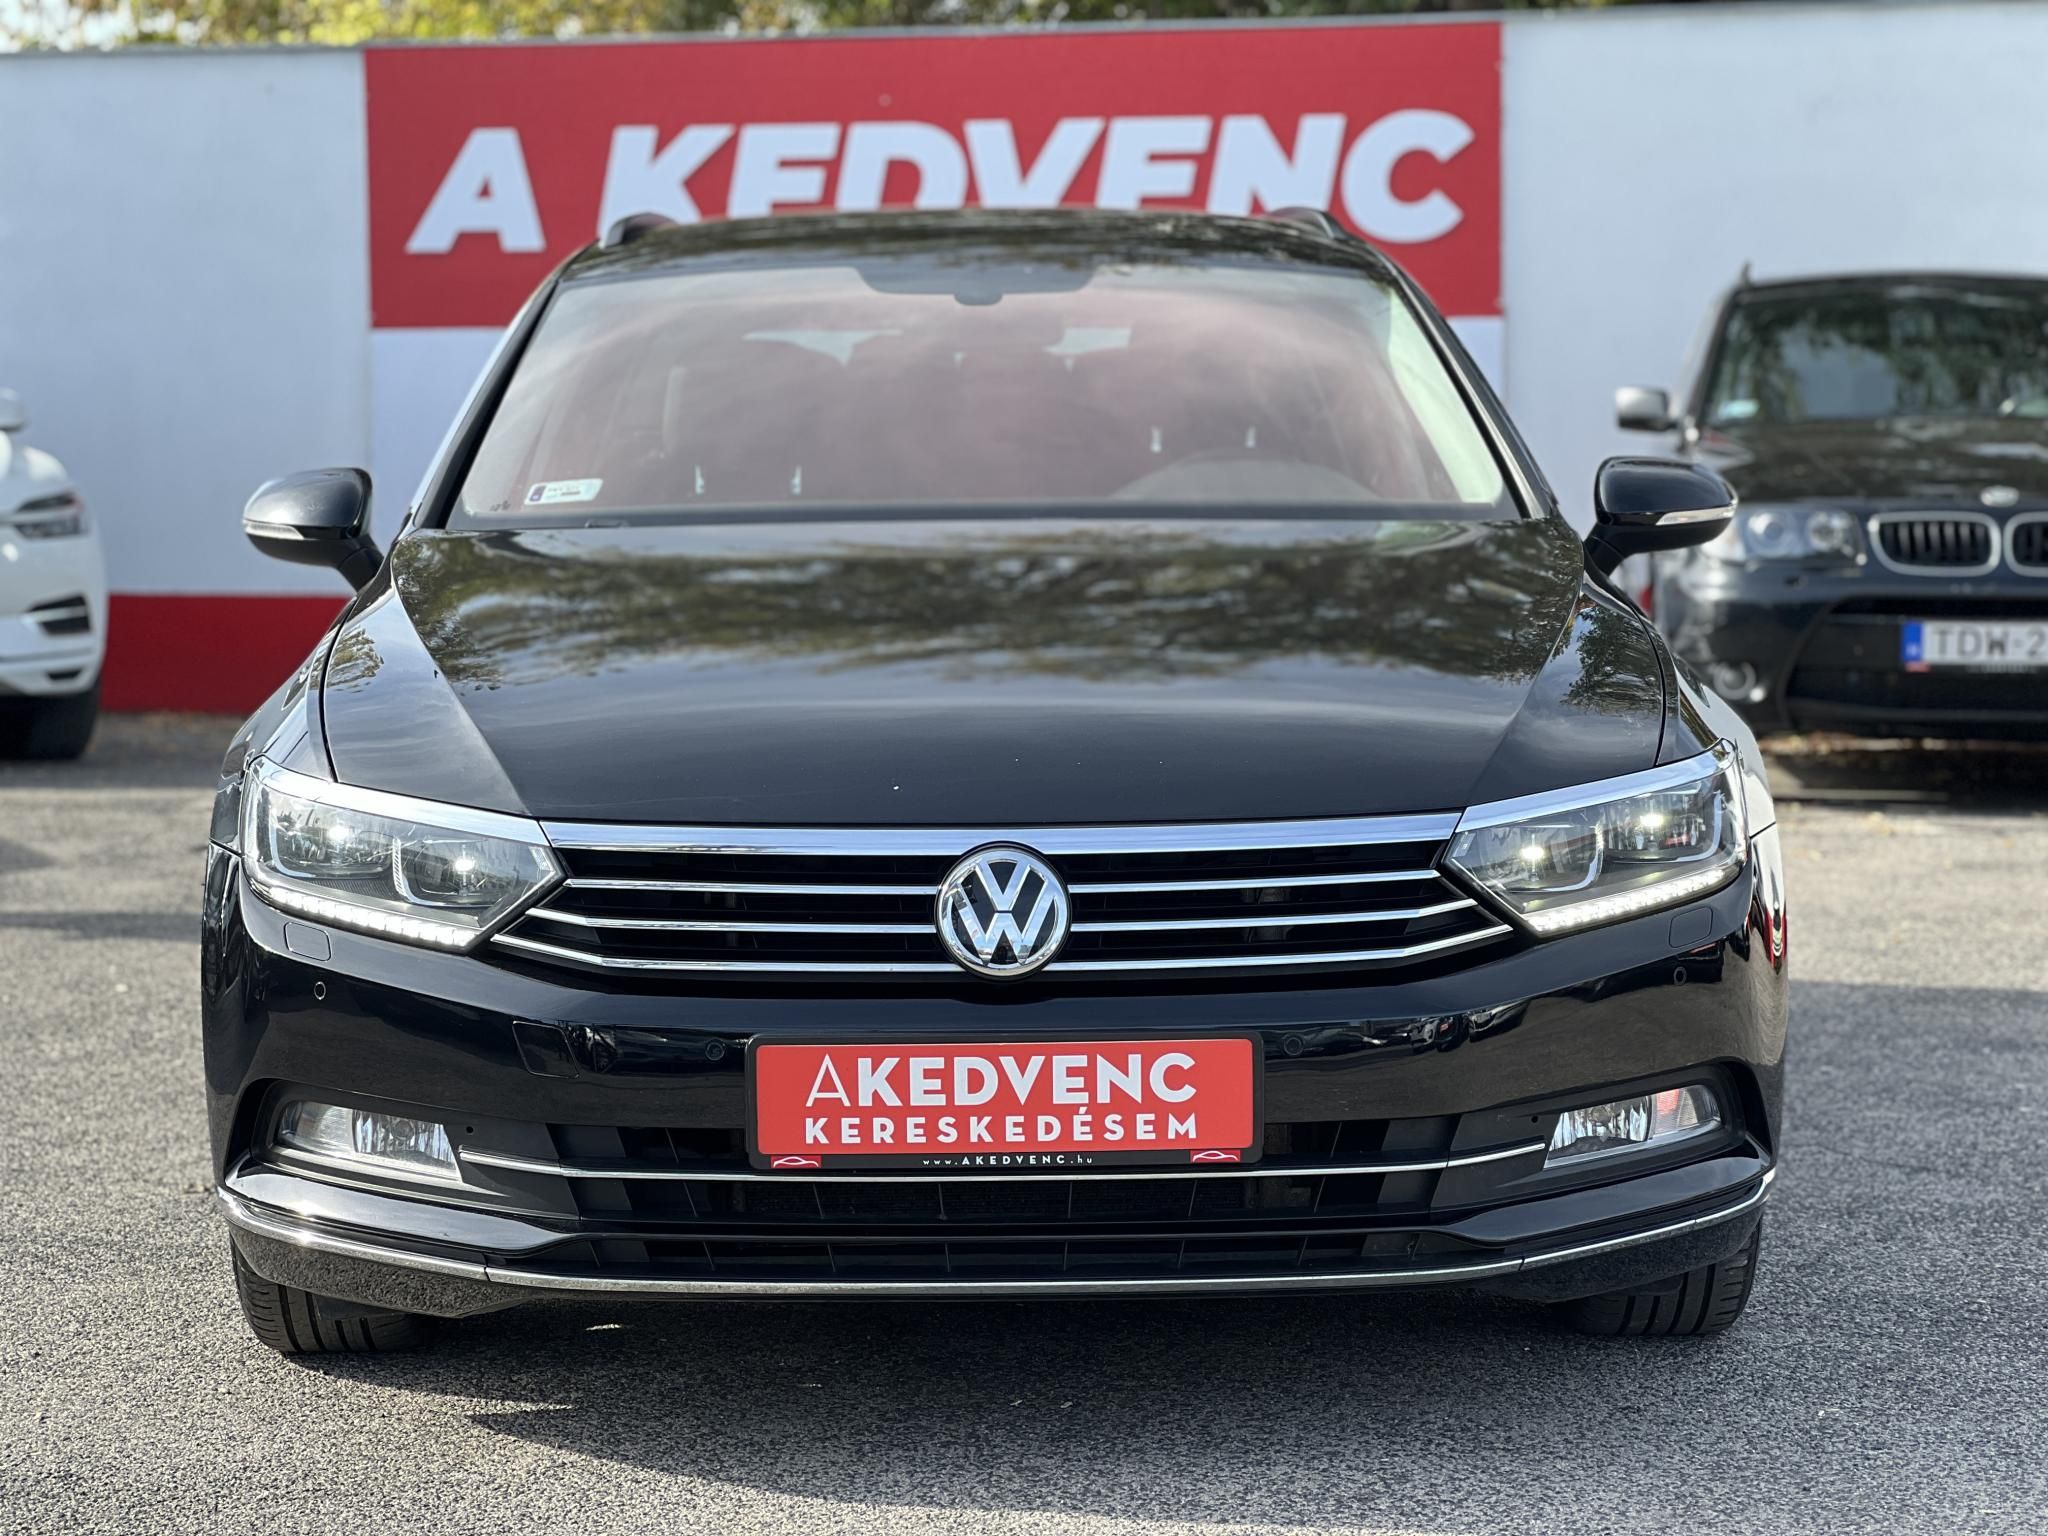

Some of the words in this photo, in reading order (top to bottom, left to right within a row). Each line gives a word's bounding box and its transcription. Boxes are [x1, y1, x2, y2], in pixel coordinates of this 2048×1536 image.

[405, 127, 546, 253] A
[598, 109, 1475, 248] KEDVENC
[805, 1052, 1198, 1108] AKEDVENC
[804, 1106, 1198, 1145] KERESKEDÉSEM
[922, 1154, 1094, 1166] www.AKEDVENC.hu
